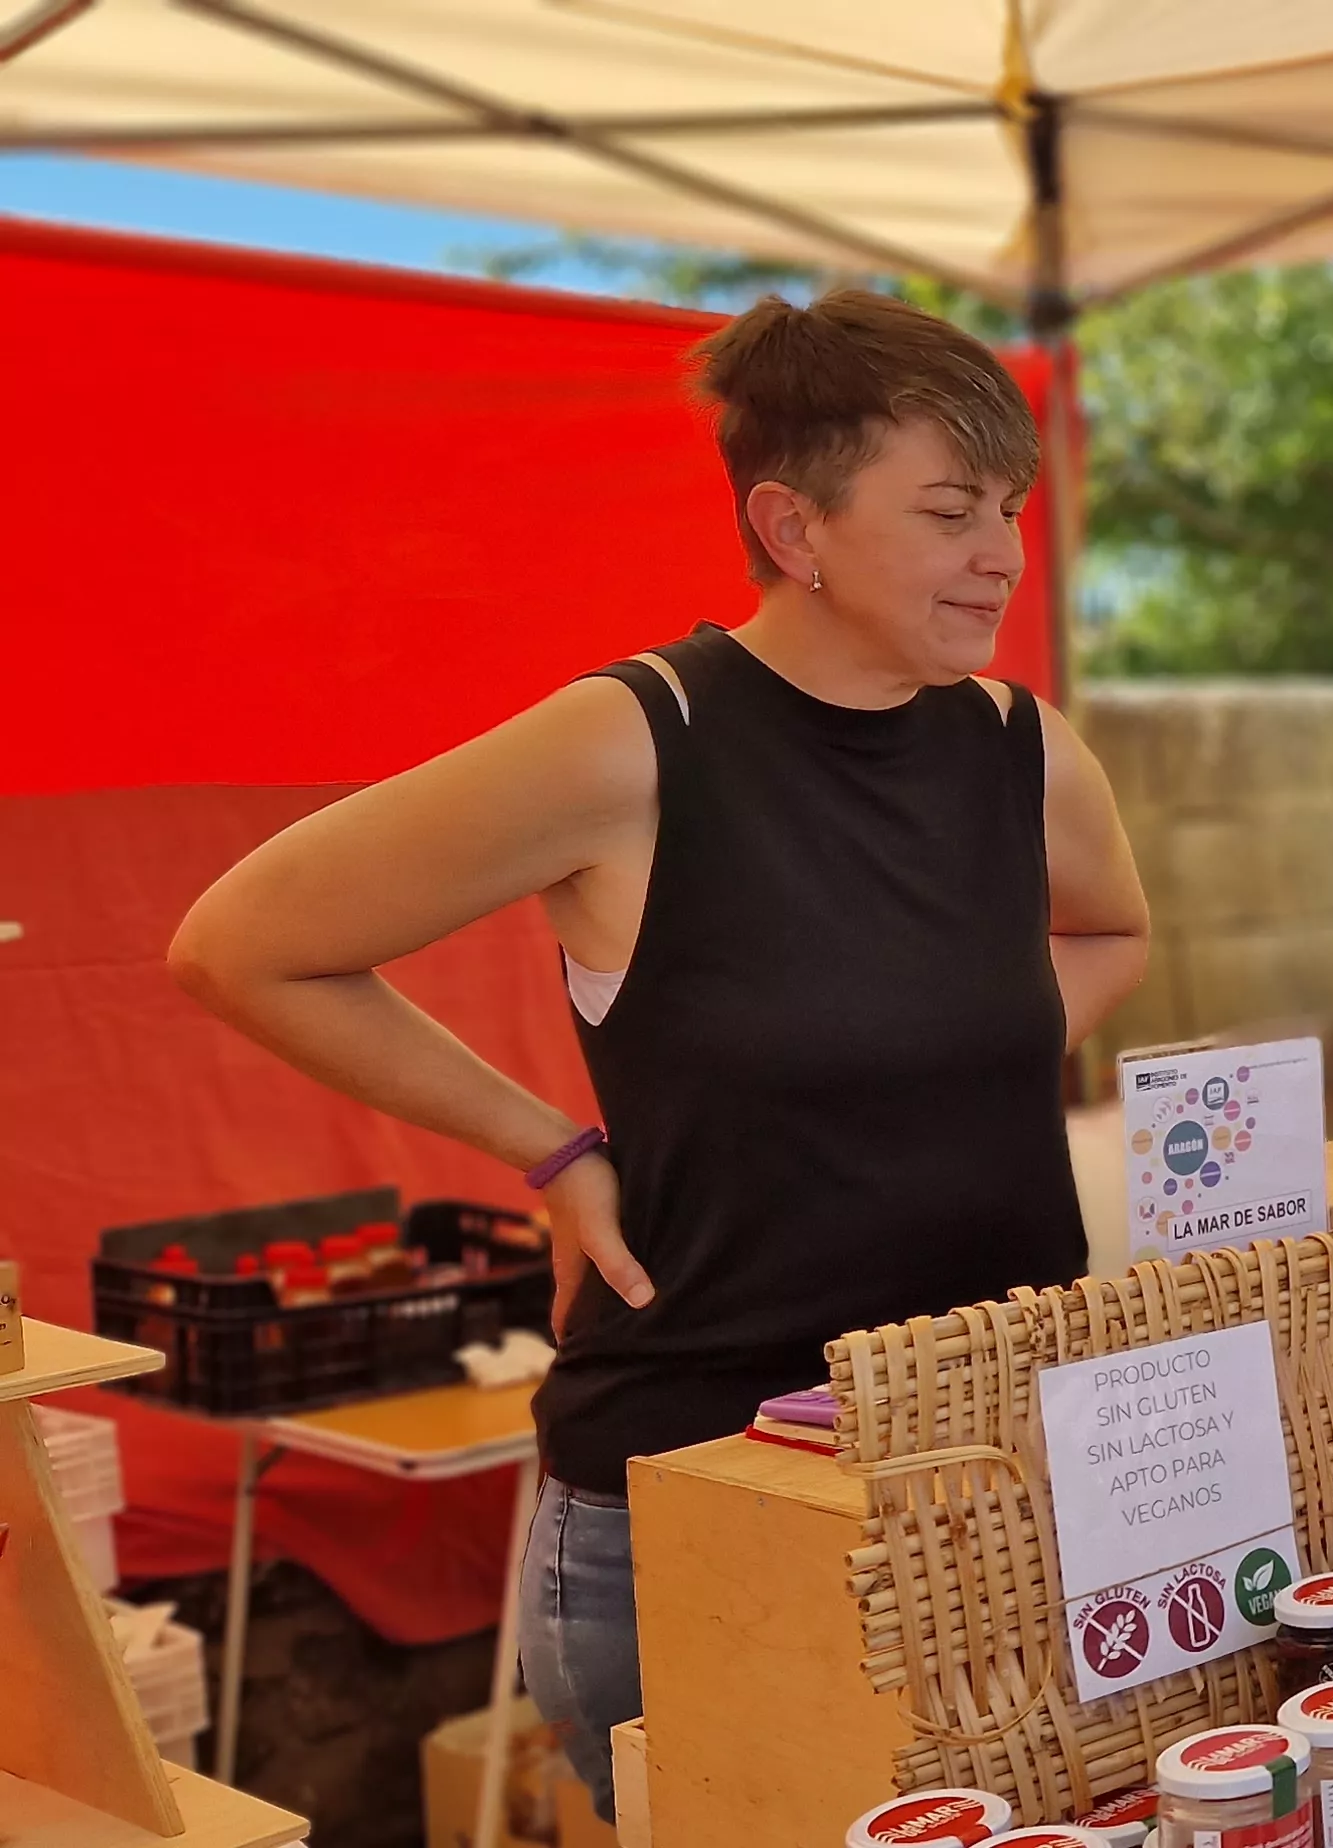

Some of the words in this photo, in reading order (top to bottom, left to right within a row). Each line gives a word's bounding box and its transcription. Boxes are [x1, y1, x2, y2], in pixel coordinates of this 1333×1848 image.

[1174, 1222, 1193, 1240] LA
[1198, 1214, 1230, 1235] MAR
[1235, 1208, 1253, 1228] DE
[1258, 1198, 1307, 1222] SABOR
[1094, 1349, 1211, 1391] PRODUCTO
[1097, 1403, 1132, 1427] SIN
[1137, 1382, 1217, 1417] GLUTEN
[1087, 1440, 1123, 1465] SIN
[1130, 1417, 1218, 1455] LACTOSA
[1222, 1411, 1234, 1430] Y
[1110, 1463, 1167, 1496] APTO
[1173, 1448, 1226, 1478] PARA
[1122, 1483, 1222, 1527] VEGANOS
[1073, 1606, 1096, 1631] SIN
[1093, 1585, 1151, 1611] GLUTEN
[1157, 1579, 1178, 1610] SIN
[1174, 1562, 1228, 1591] LACTOSA
